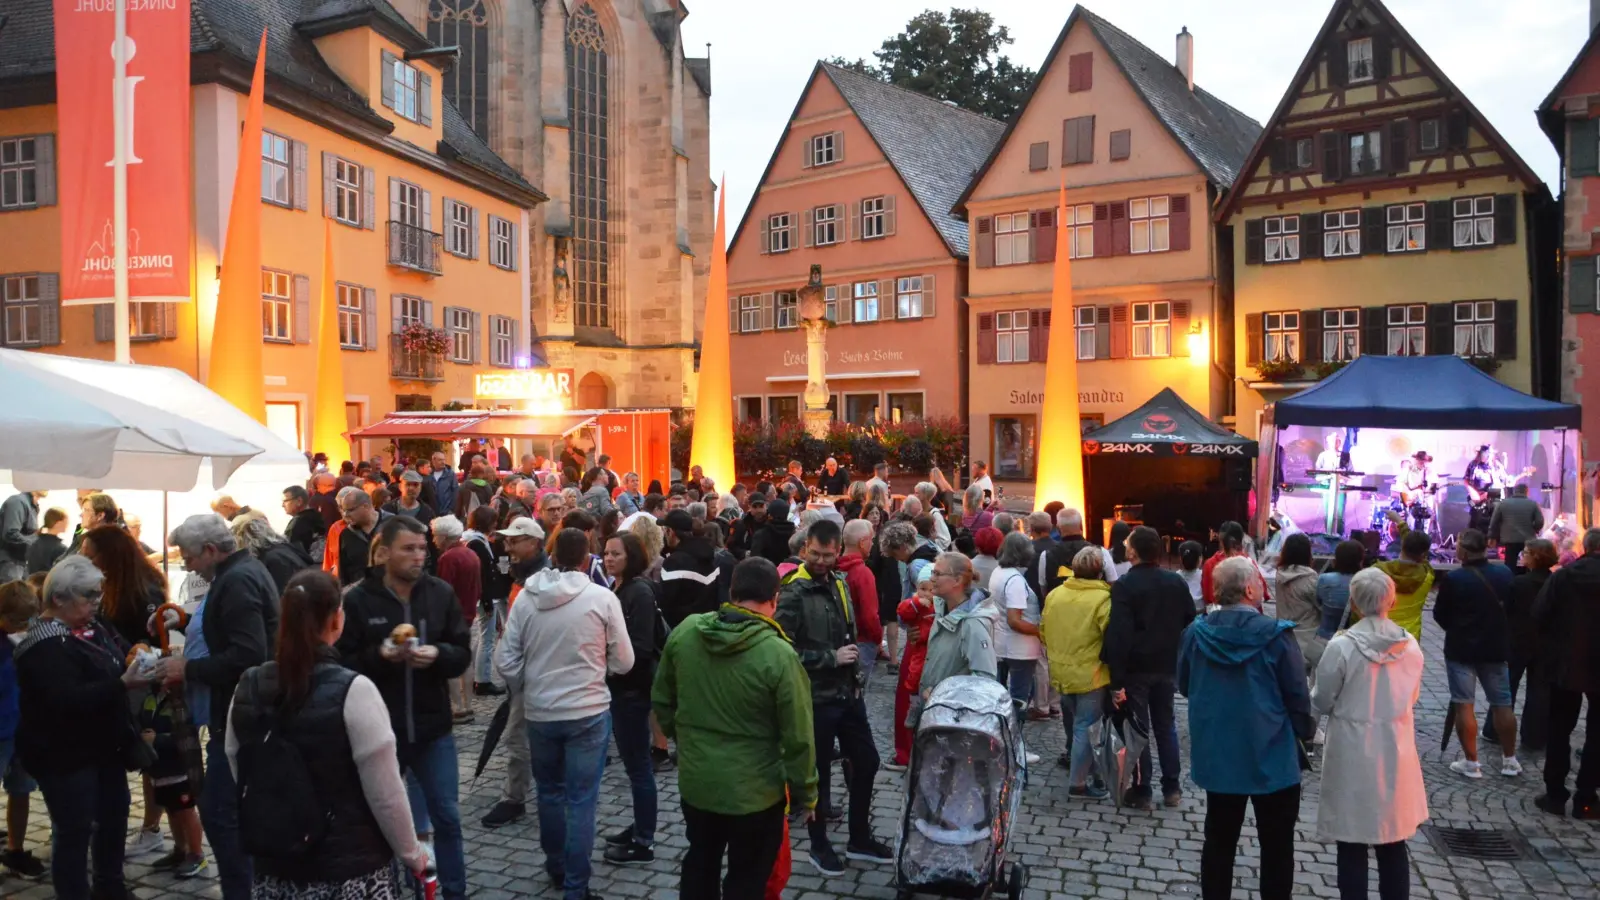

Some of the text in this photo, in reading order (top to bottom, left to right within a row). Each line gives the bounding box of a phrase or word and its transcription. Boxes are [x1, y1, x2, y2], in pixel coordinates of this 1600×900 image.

[1010, 390, 1045, 405] Salon
[1131, 433, 1186, 441] 24MX
[1101, 443, 1154, 453] 24MX
[1190, 443, 1244, 454] 24MX
